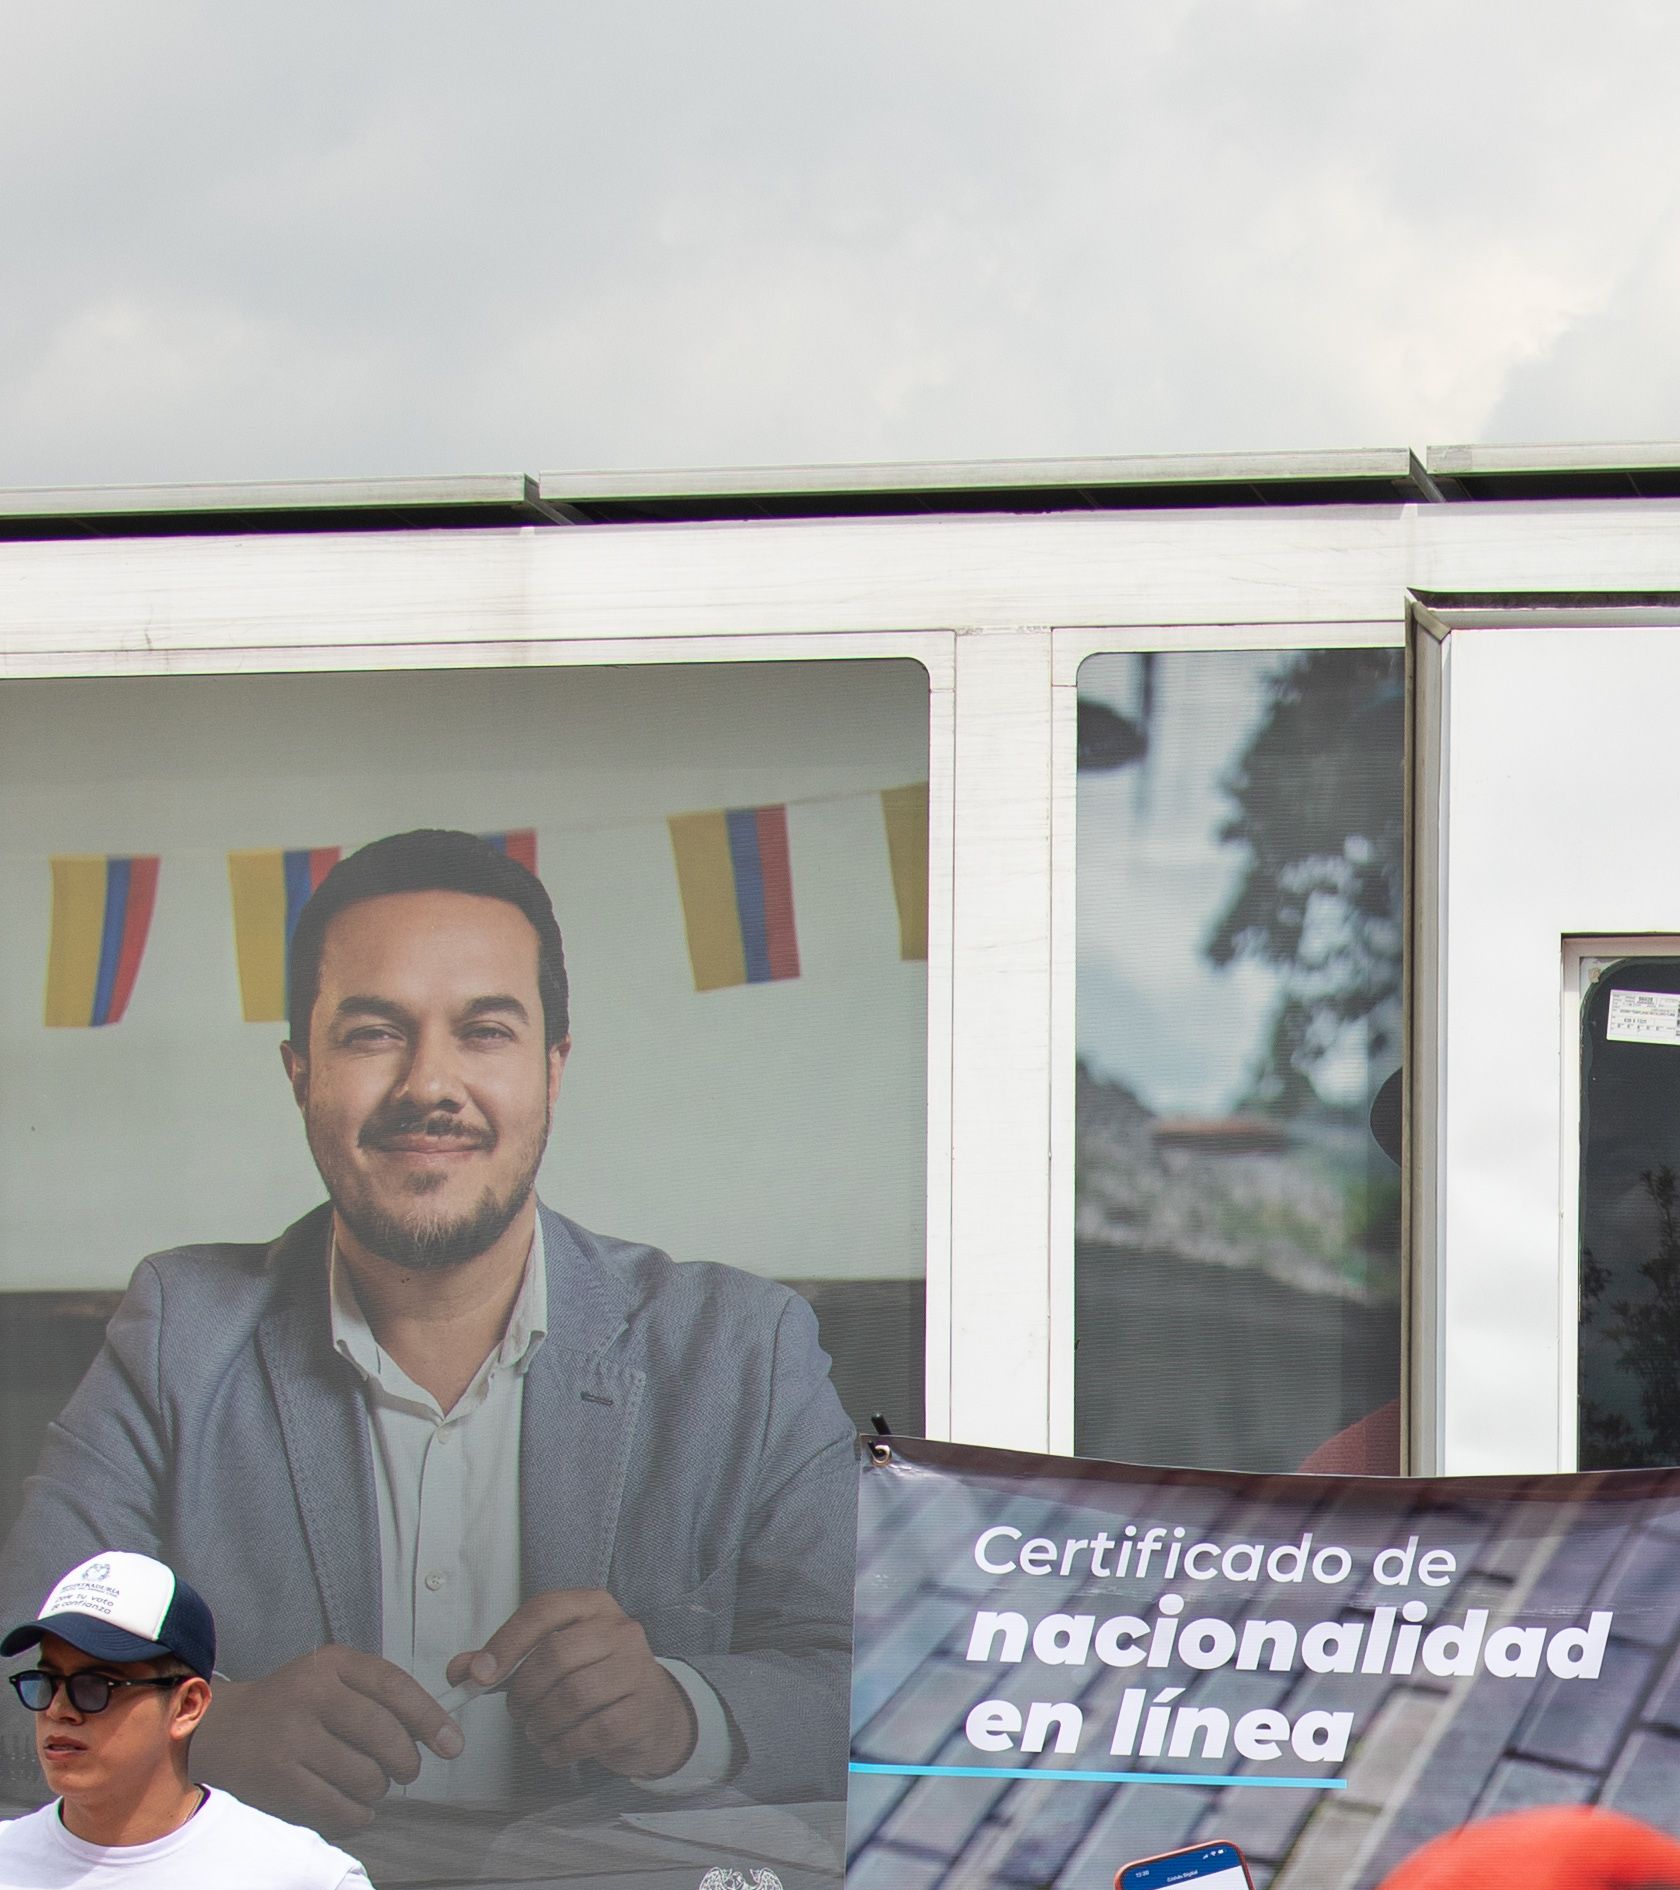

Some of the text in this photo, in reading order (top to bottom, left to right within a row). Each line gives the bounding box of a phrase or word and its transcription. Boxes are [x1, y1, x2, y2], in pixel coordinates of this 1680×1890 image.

[974, 1524, 1457, 1588] Certificado de
[966, 1593, 1613, 1680] nacionalidad
[966, 1687, 1354, 1764] en línea
